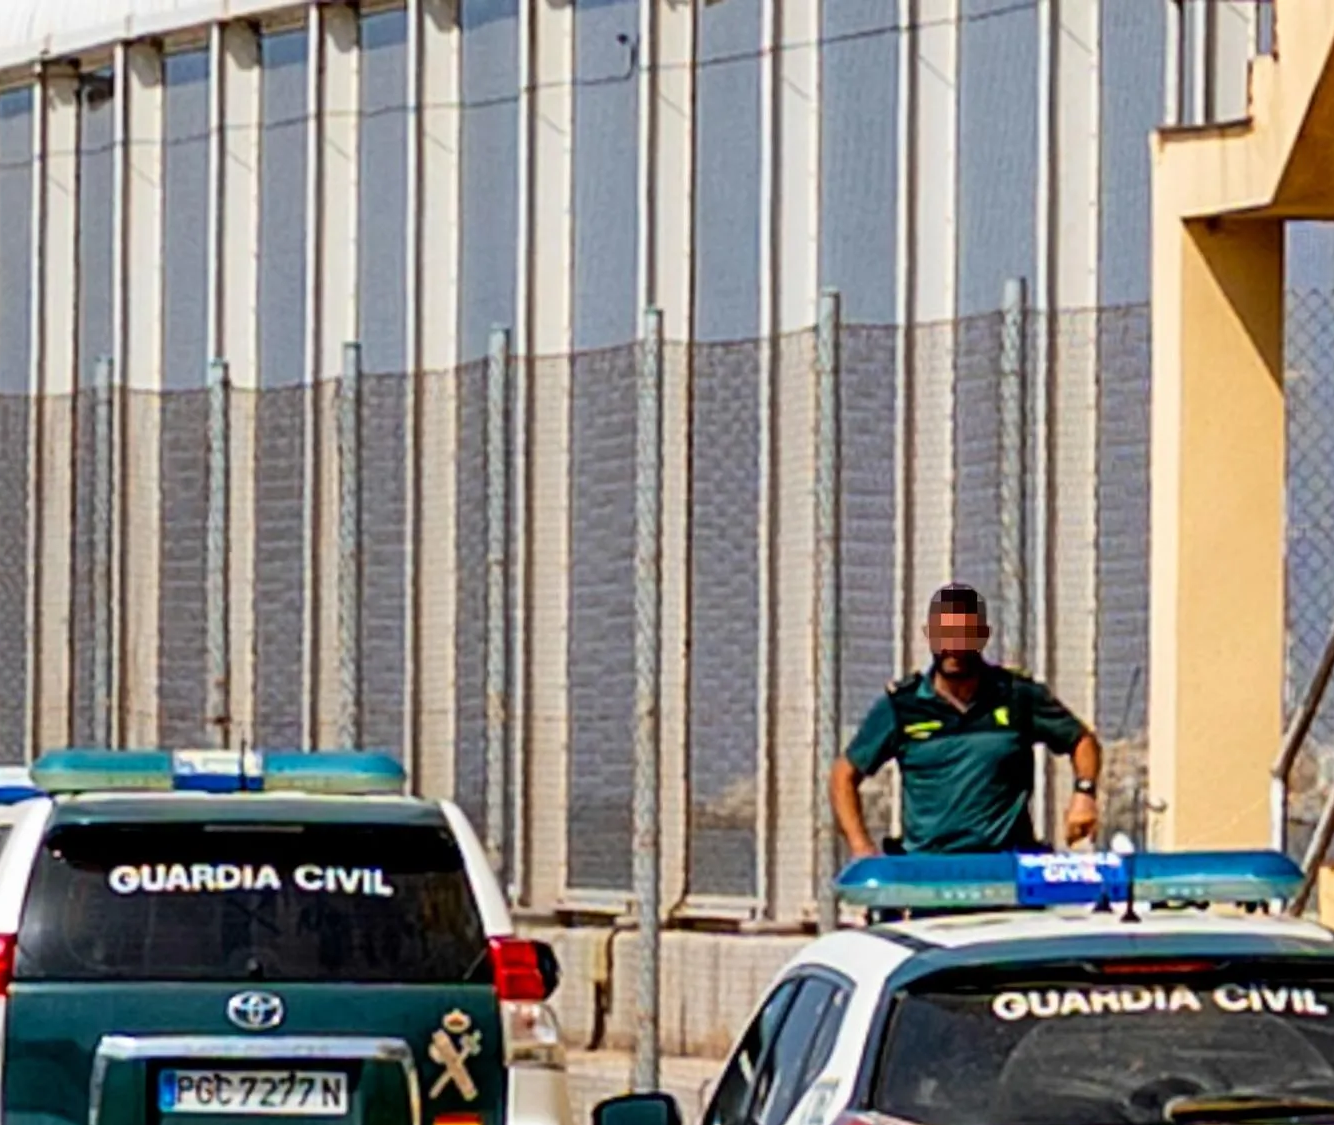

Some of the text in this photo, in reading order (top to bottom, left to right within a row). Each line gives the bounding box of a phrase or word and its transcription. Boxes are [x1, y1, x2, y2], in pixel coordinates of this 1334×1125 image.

[109, 863, 395, 898] GUARDIA CIVIL
[992, 982, 1329, 1020] GUARDIA CIVIL
[177, 1073, 342, 1108] PGC 7277 N
